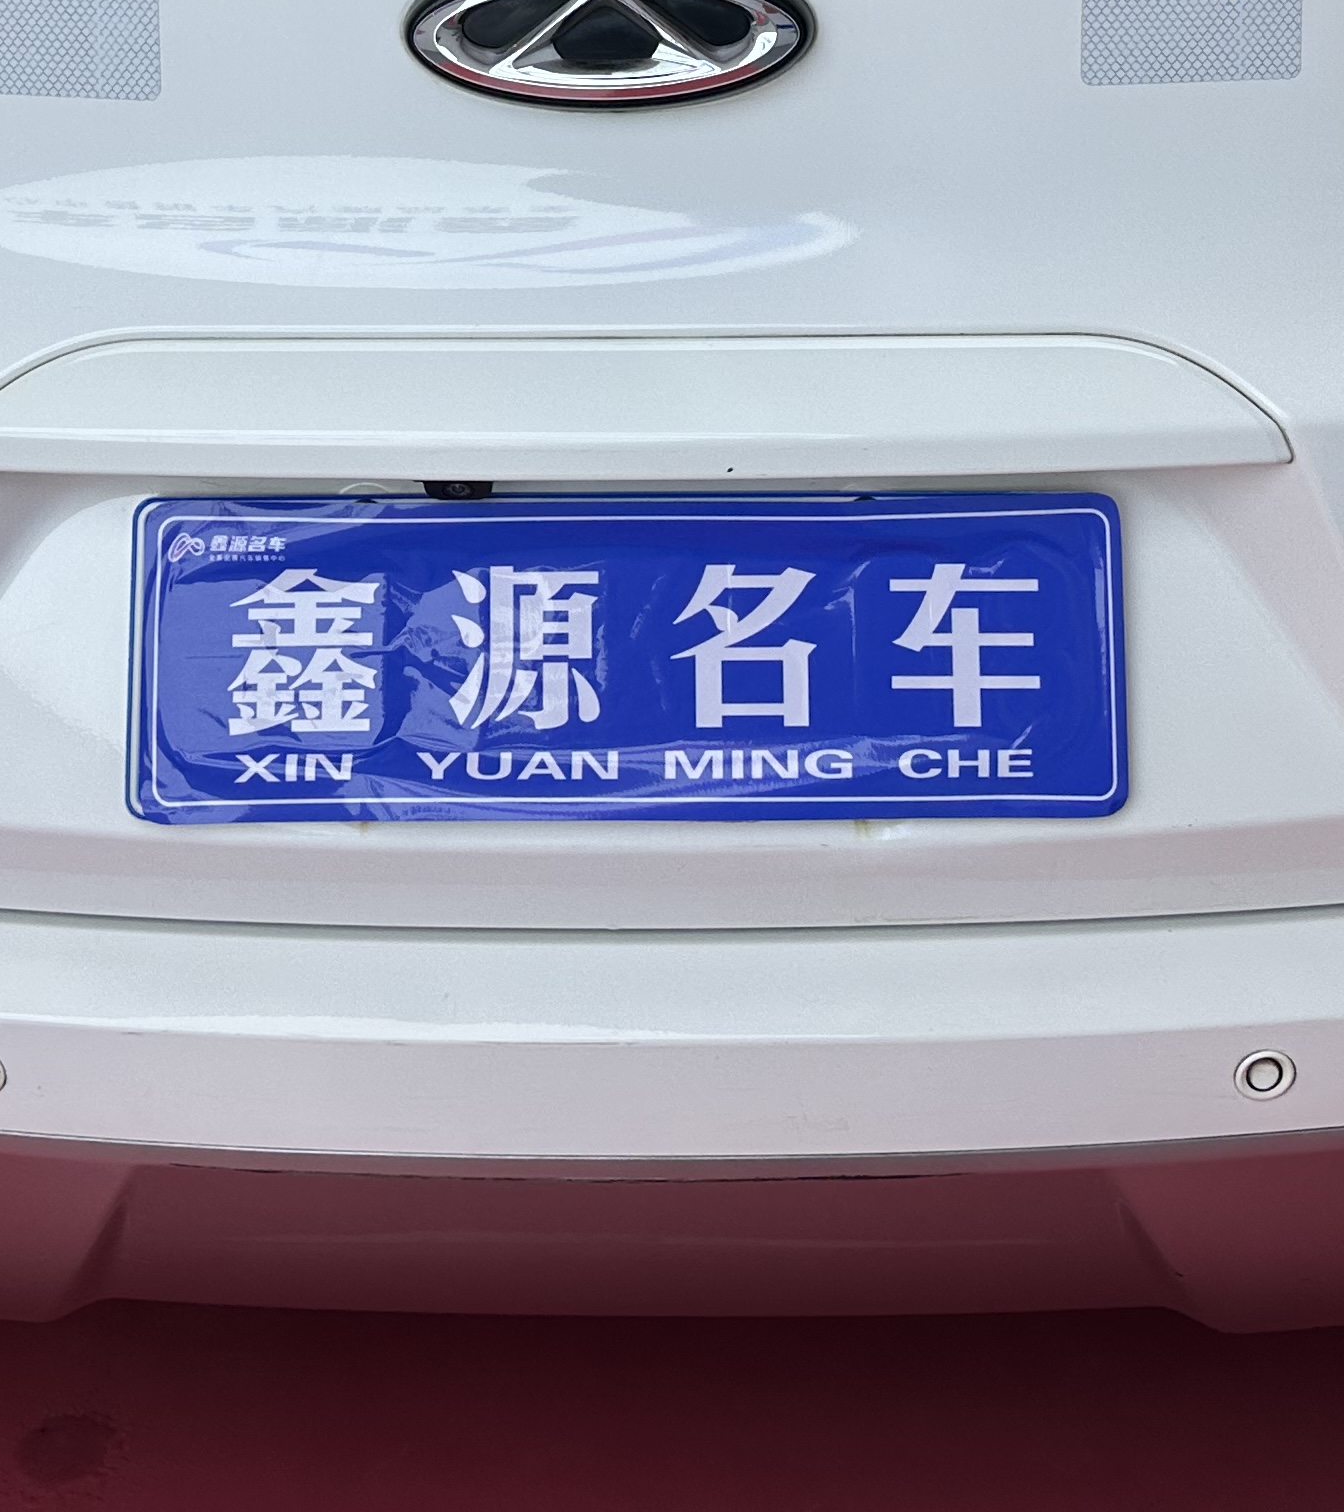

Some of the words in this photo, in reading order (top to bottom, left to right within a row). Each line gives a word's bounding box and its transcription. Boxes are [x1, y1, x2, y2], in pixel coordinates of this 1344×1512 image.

[227, 563, 1041, 736] 鑫源名车
[234, 753, 355, 784] XIN
[416, 750, 619, 781] YUAN
[664, 749, 854, 780] MING
[898, 748, 1034, 779] CHE
